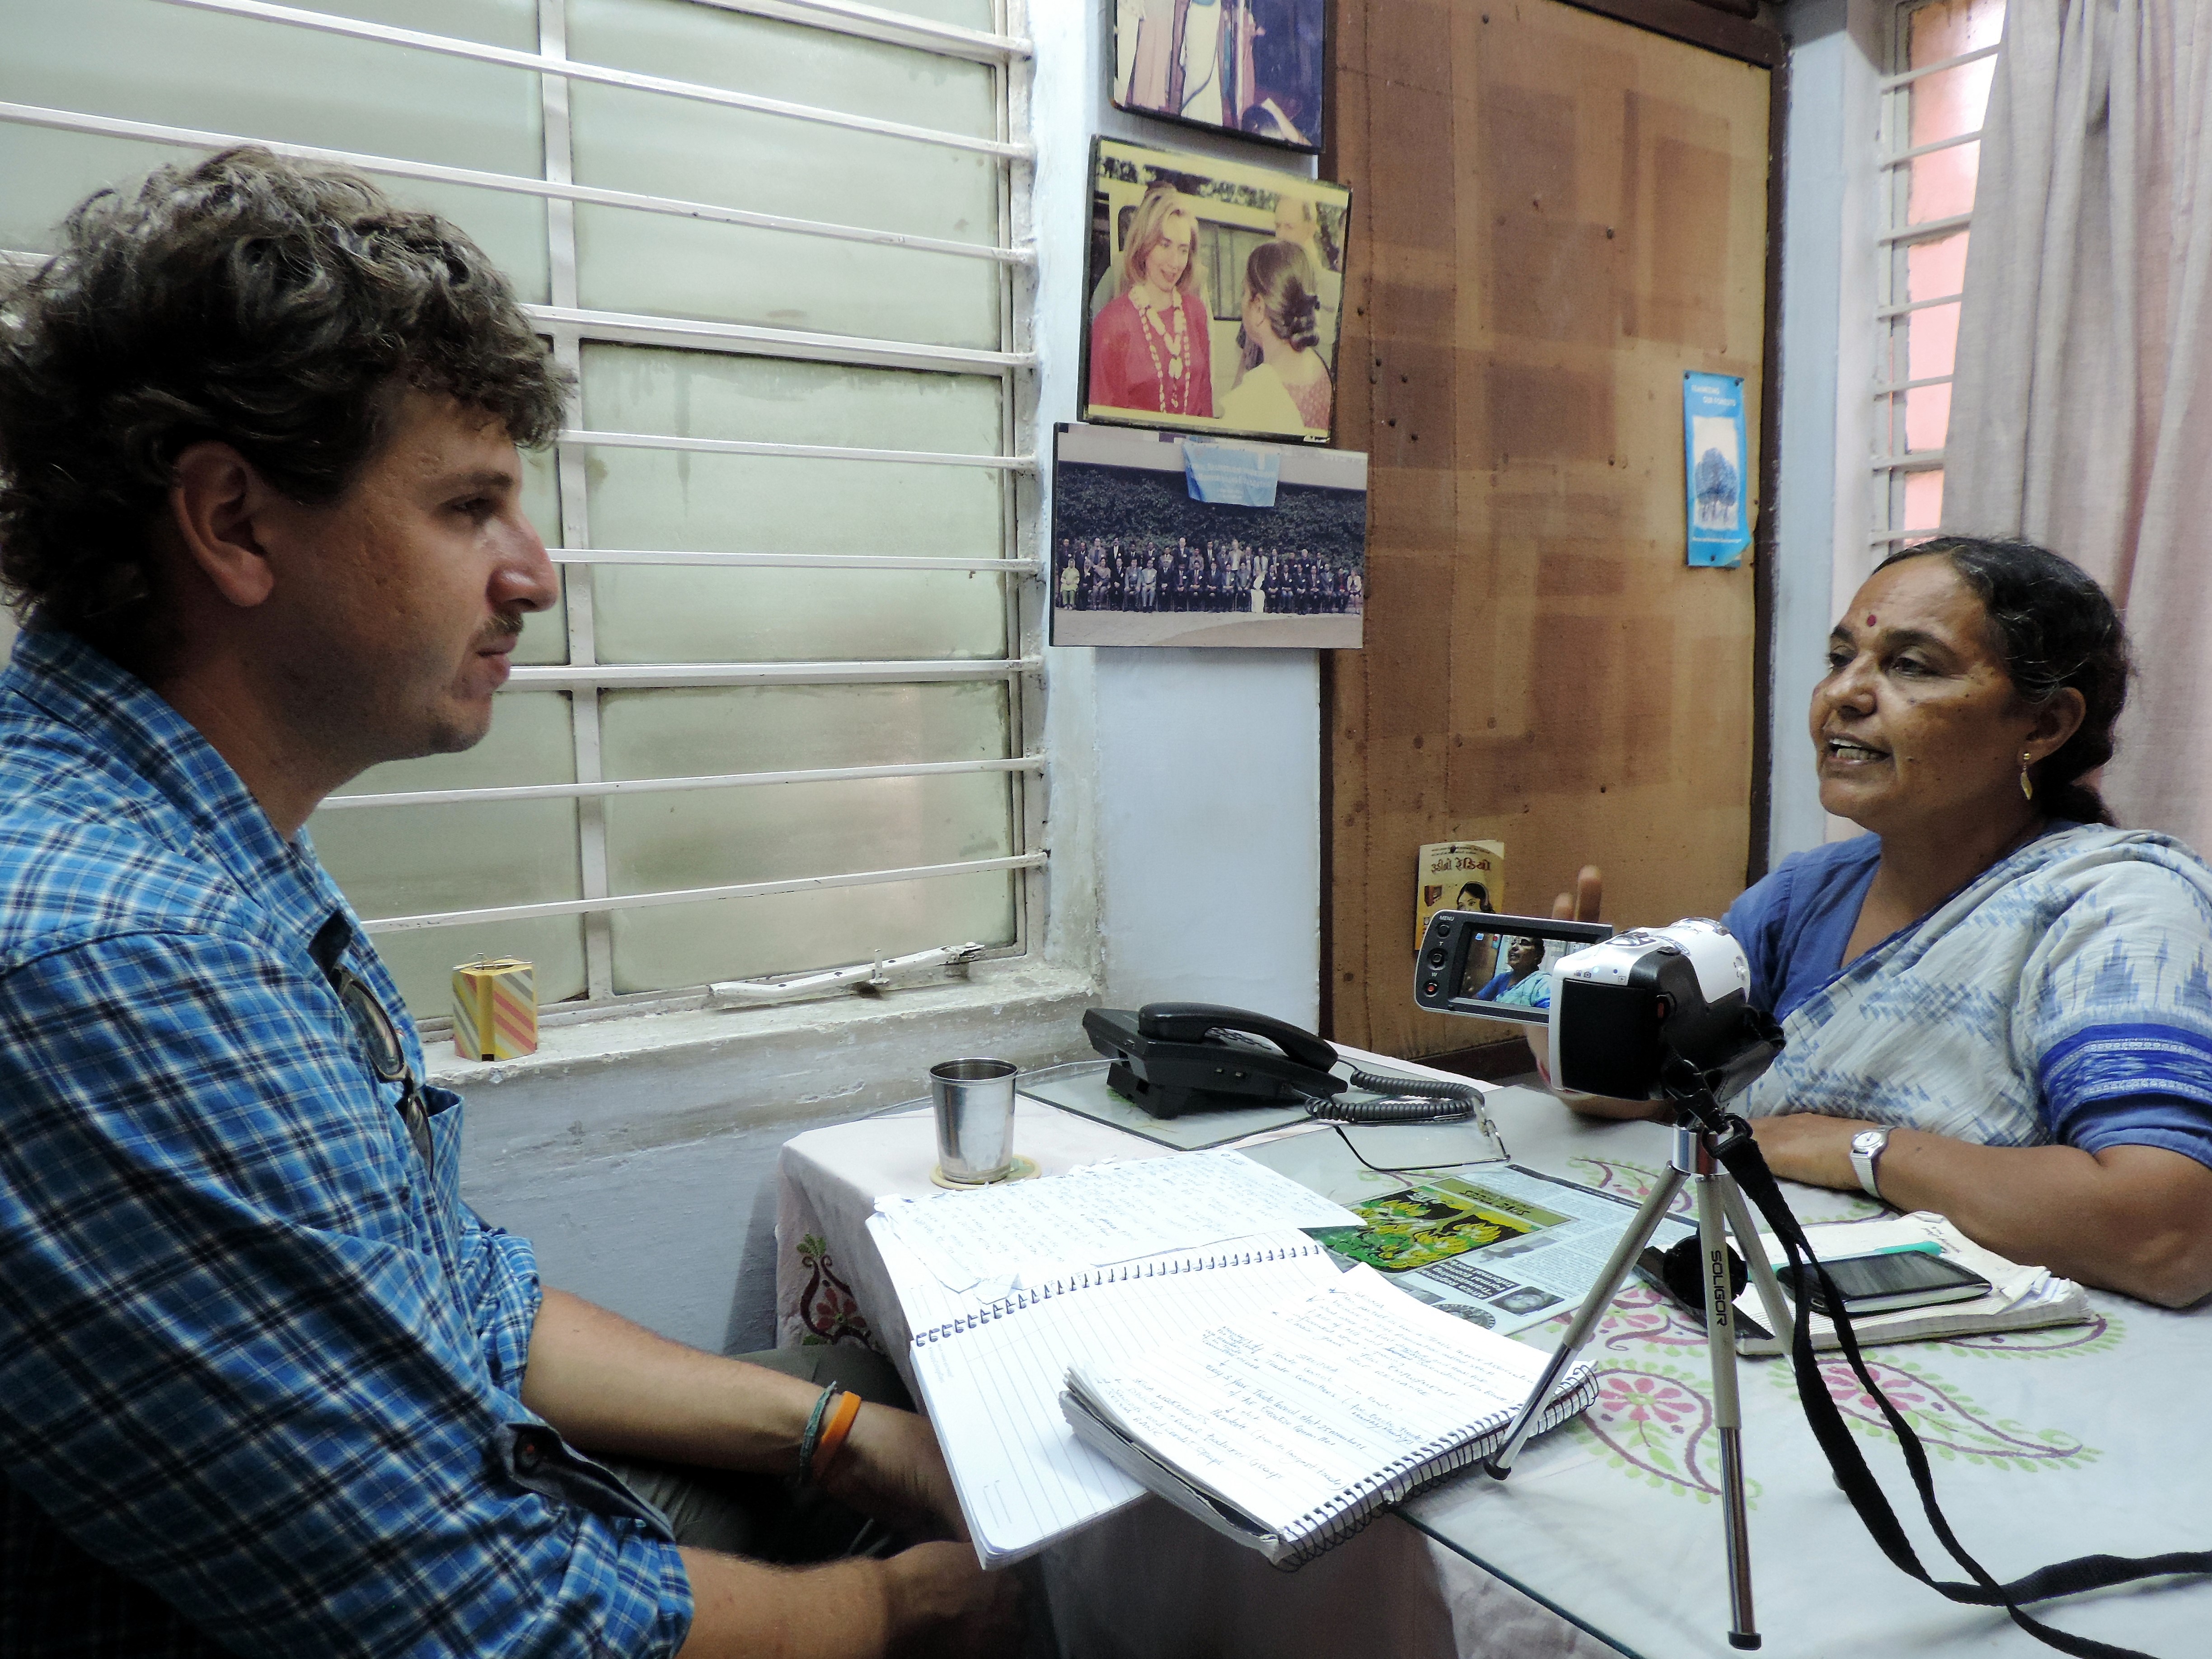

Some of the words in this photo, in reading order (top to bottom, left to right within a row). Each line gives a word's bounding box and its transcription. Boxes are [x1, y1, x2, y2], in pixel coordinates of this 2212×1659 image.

[1473, 1270, 1515, 1288] Informal
[1709, 1250, 1728, 1326] SOLIGOR
[1458, 1285, 1488, 1298] Africa
